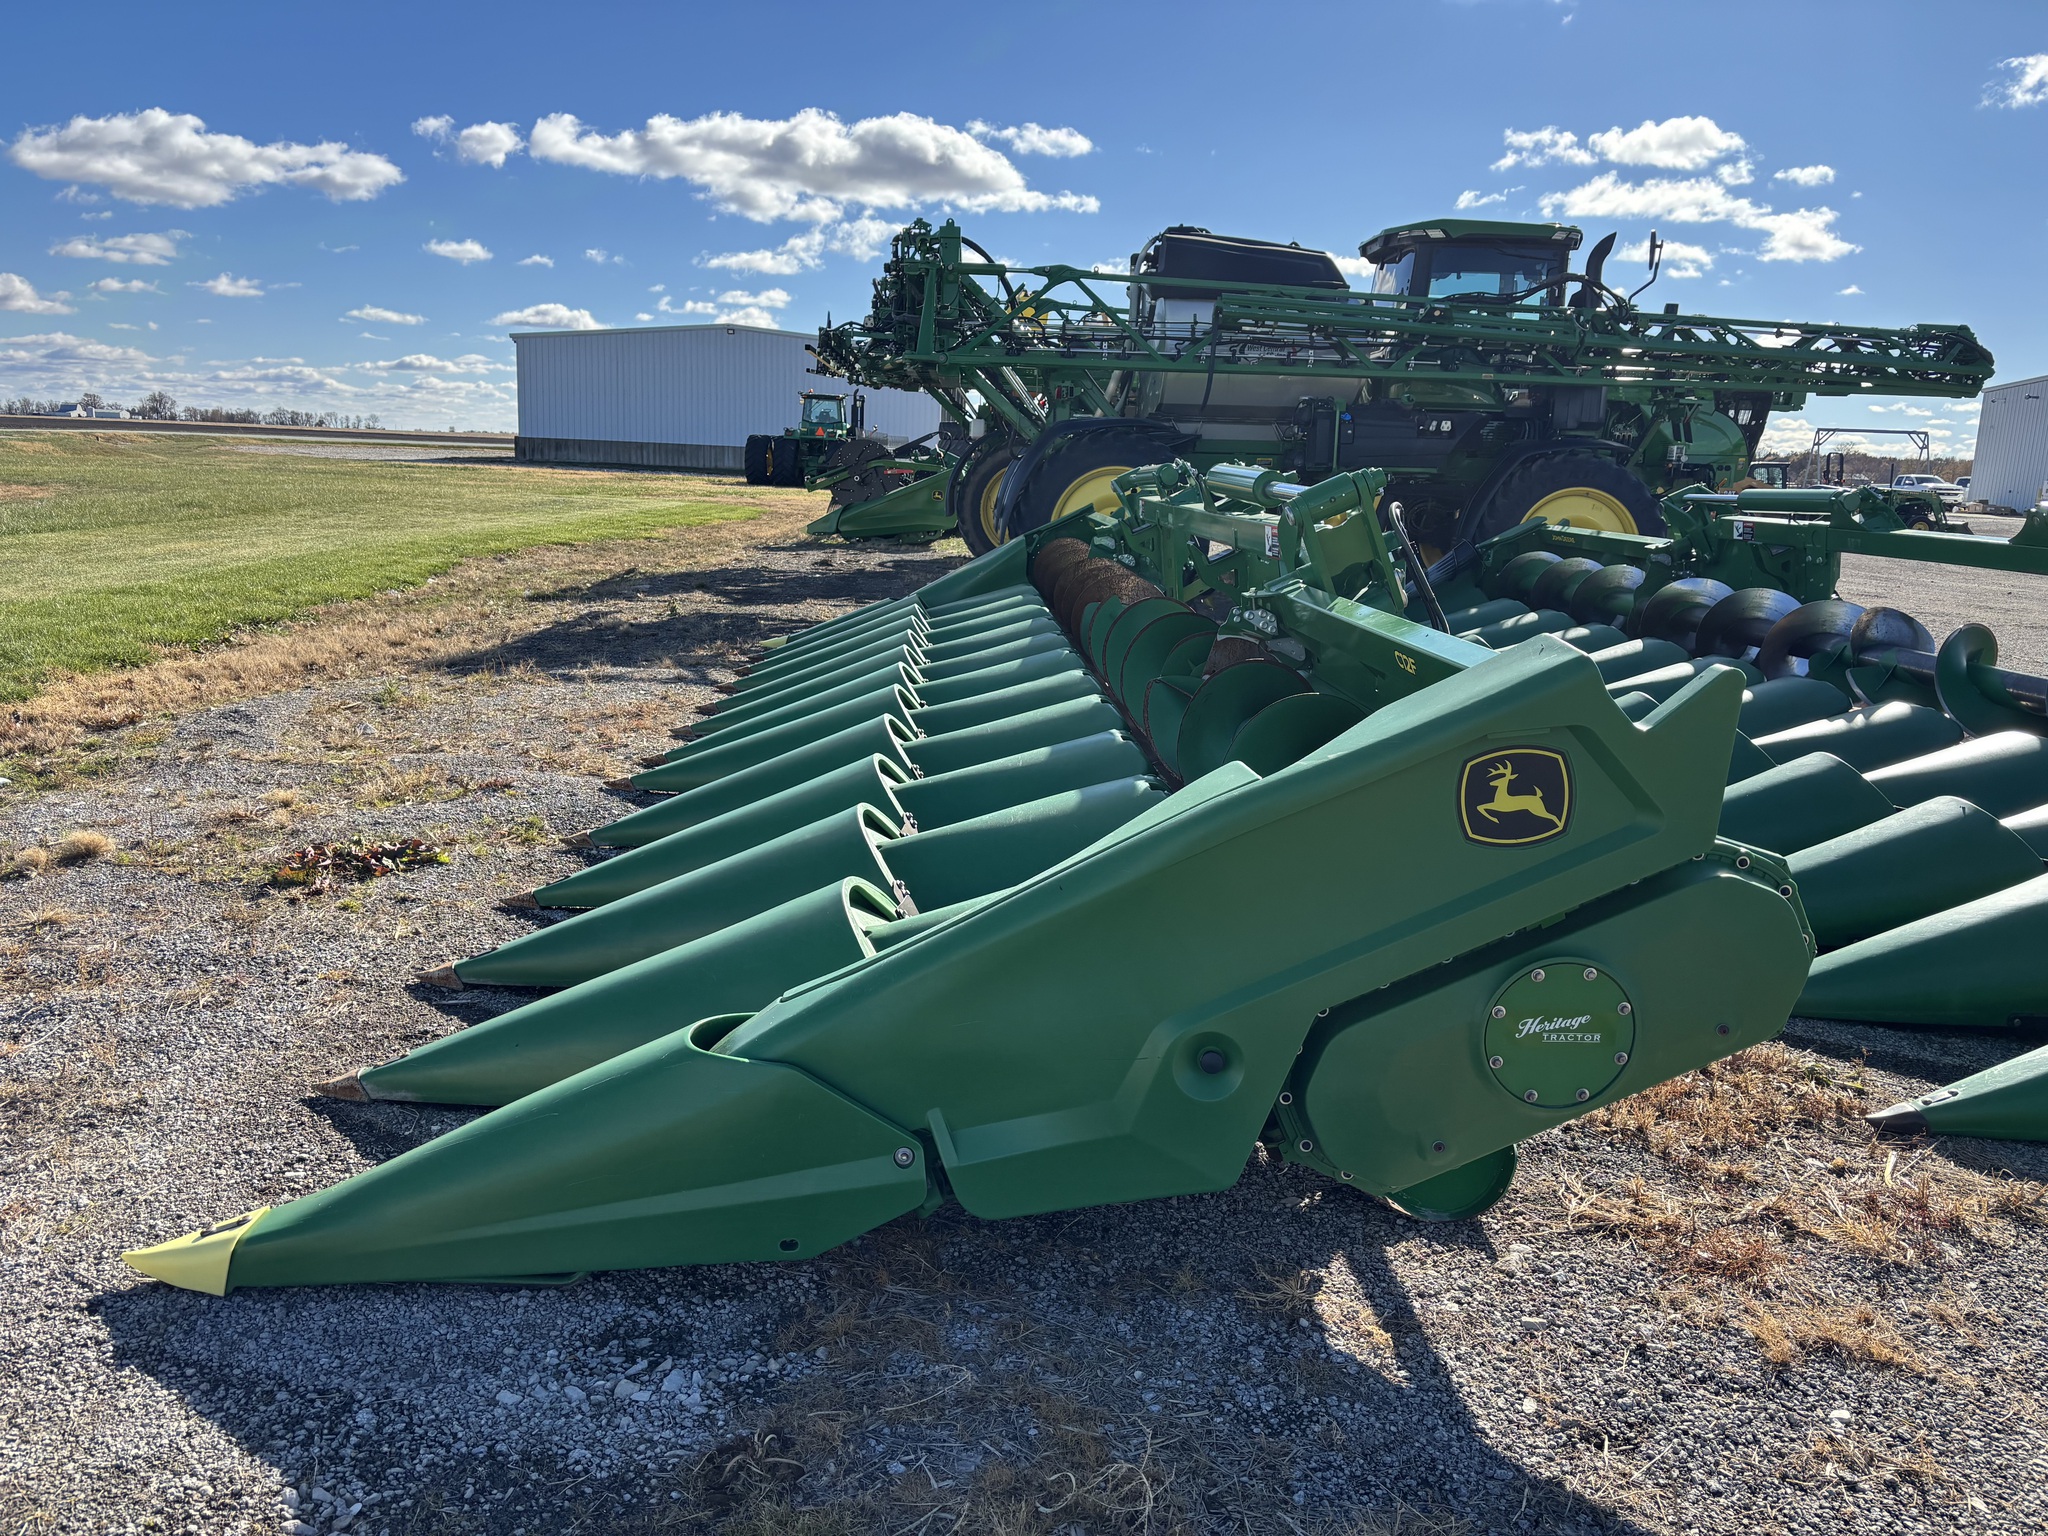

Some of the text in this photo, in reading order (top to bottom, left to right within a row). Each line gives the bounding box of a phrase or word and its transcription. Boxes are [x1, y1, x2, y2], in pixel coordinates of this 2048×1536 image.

[1247, 344, 1263, 352] West
[1515, 1014, 1592, 1039] Heritage
[1543, 1033, 1602, 1042] TRACTOR
